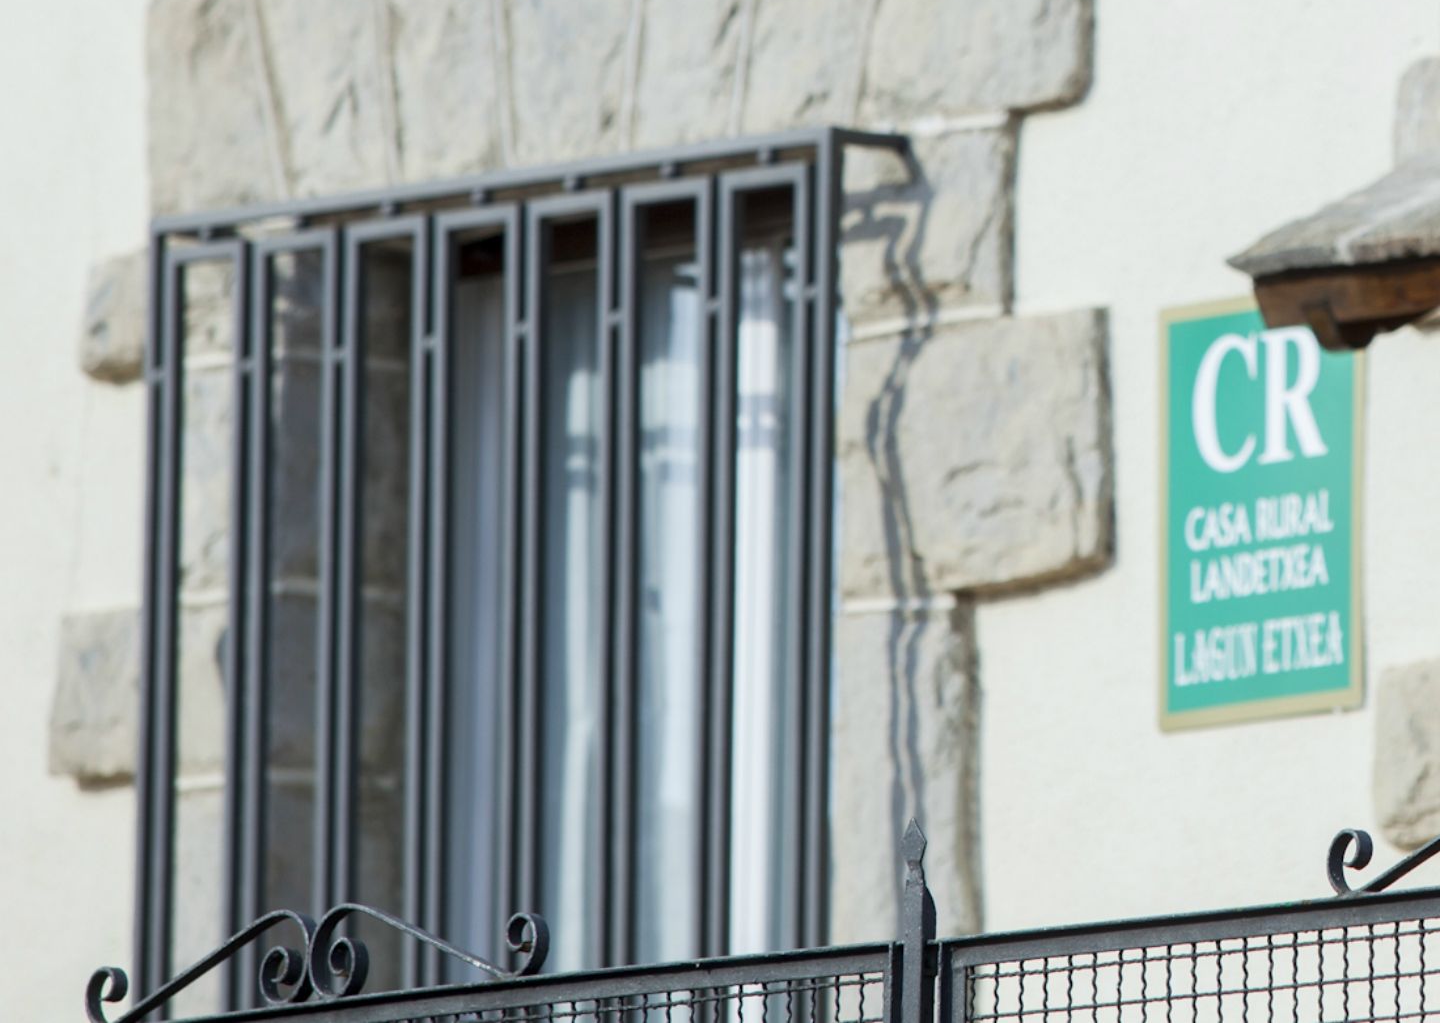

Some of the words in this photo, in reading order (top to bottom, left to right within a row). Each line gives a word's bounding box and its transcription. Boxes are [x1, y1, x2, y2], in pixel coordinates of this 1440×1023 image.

[1191, 325, 1329, 474] CR
[1184, 502, 1251, 552] CASA
[1255, 489, 1334, 542] RURAL
[1189, 544, 1329, 604] LANDETXEA
[1174, 626, 1258, 687] LAGUN
[1262, 611, 1344, 674] ETXEA
